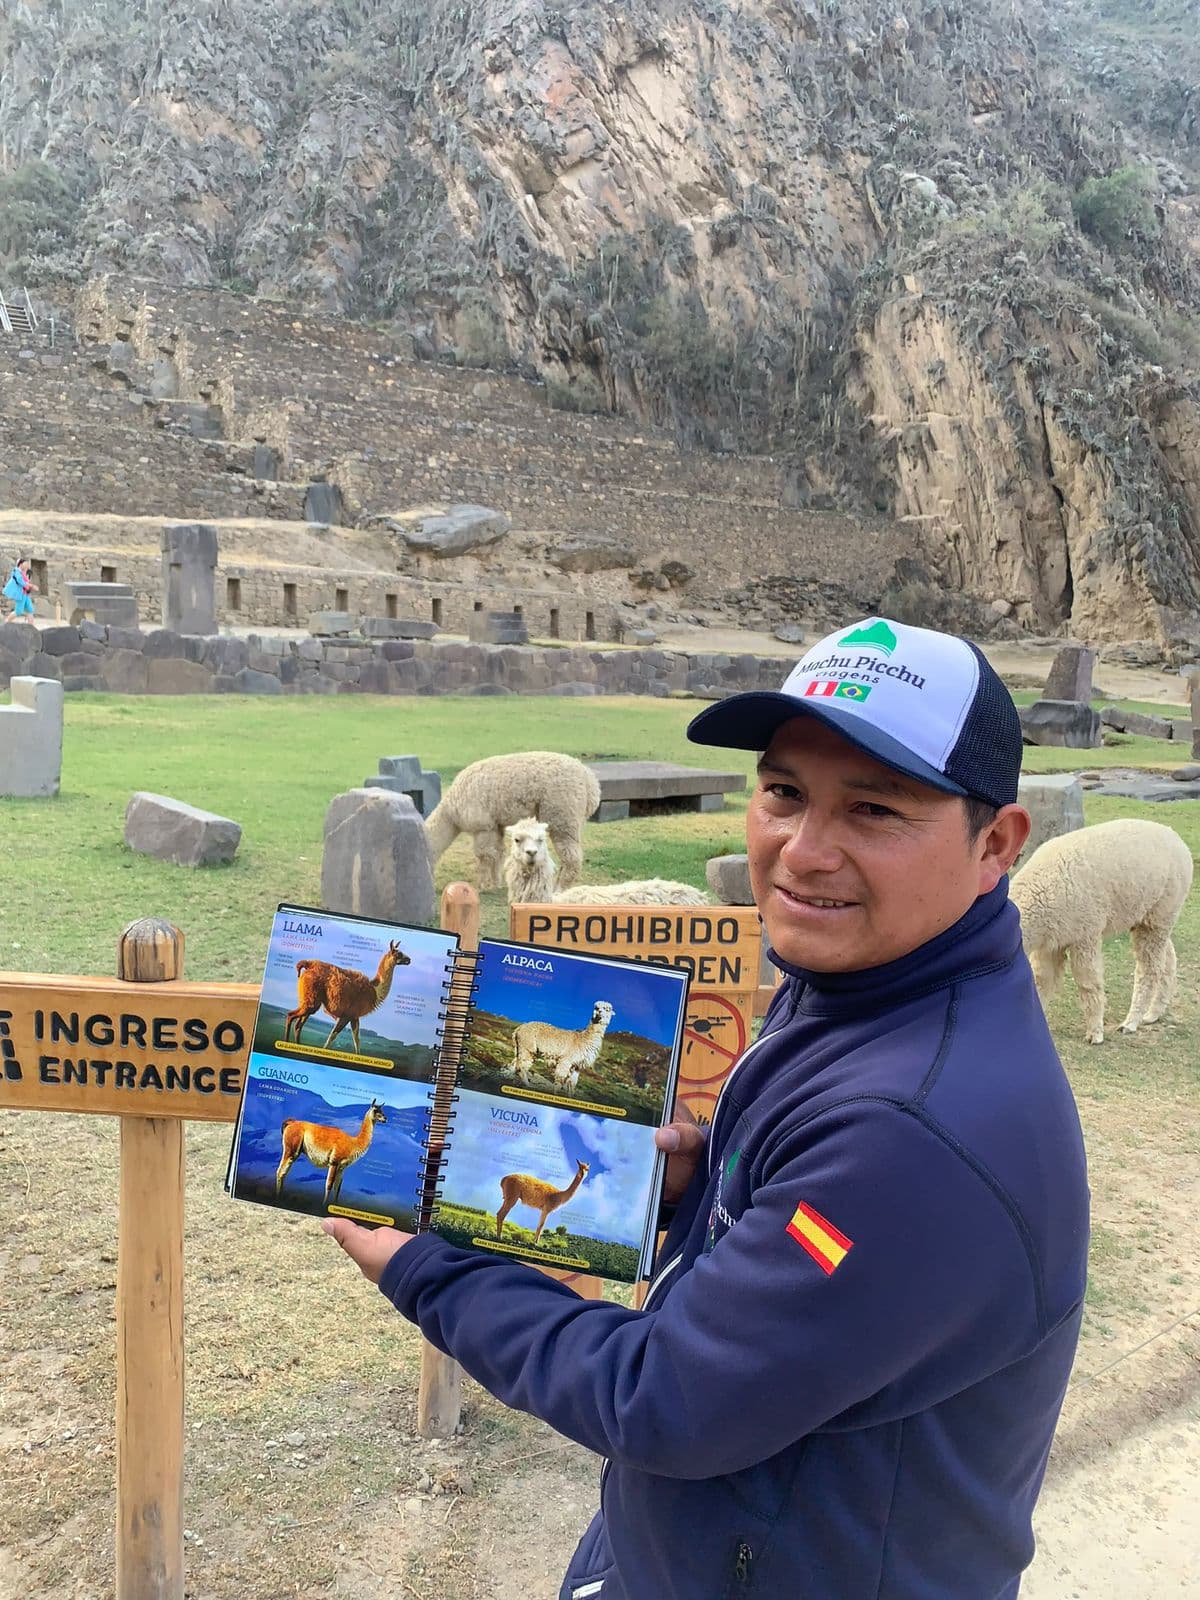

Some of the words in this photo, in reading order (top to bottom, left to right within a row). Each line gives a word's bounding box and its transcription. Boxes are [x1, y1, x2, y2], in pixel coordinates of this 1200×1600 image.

[796, 654, 851, 677] Machu
[853, 656, 927, 690] Picchu
[282, 920, 323, 937] LLAMA
[528, 915, 740, 944] PROHIBIDO
[501, 953, 554, 973] ALPACA
[34, 1009, 245, 1053] INGRESO
[39, 1055, 242, 1094] ENTRANCE
[257, 1066, 309, 1085] GUANACO
[490, 1107, 539, 1128] VICUÑA
